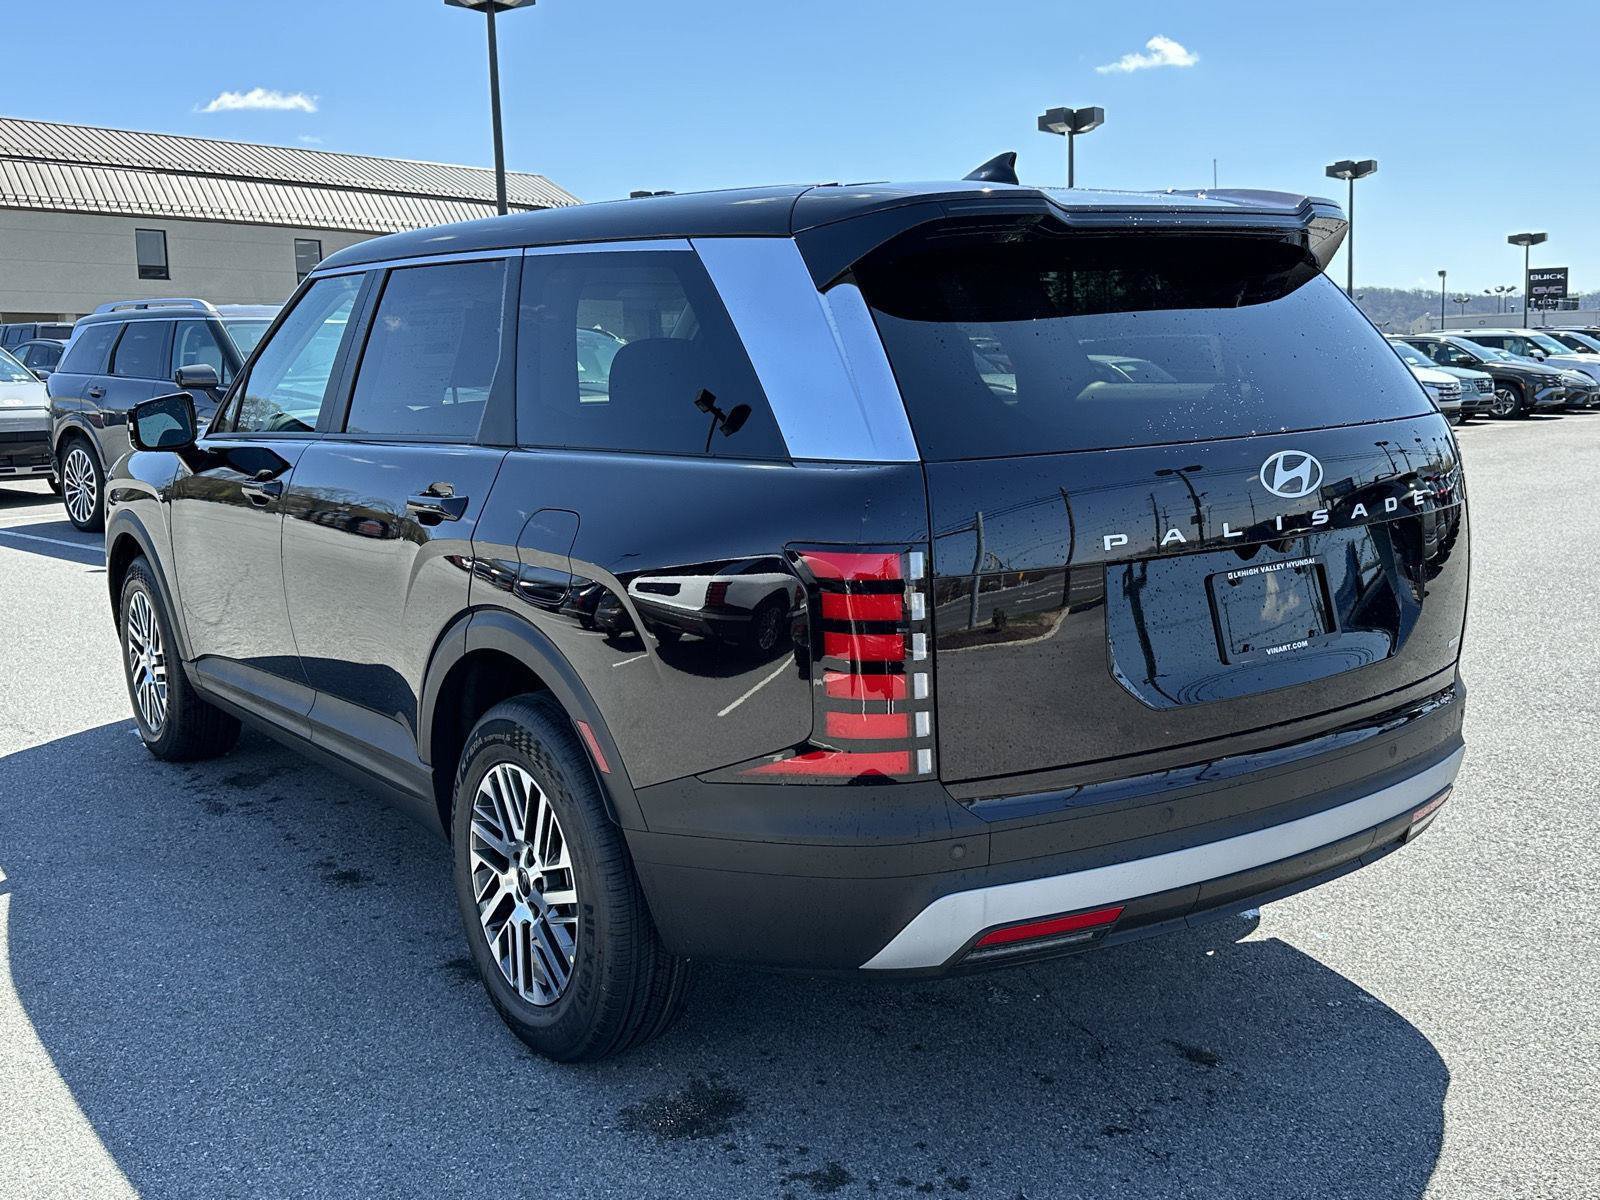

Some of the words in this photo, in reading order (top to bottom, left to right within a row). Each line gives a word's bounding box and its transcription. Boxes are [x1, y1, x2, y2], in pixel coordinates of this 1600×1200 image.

[1530, 273, 1565, 281] BUICK
[1532, 286, 1562, 294] GMC
[1103, 489, 1426, 551] PALISADE
[1233, 567, 1259, 579] LEHIGH
[1260, 562, 1285, 573] VALLEY
[1286, 557, 1316, 568] HYUNDAI
[1265, 640, 1309, 655] VINART.COM
